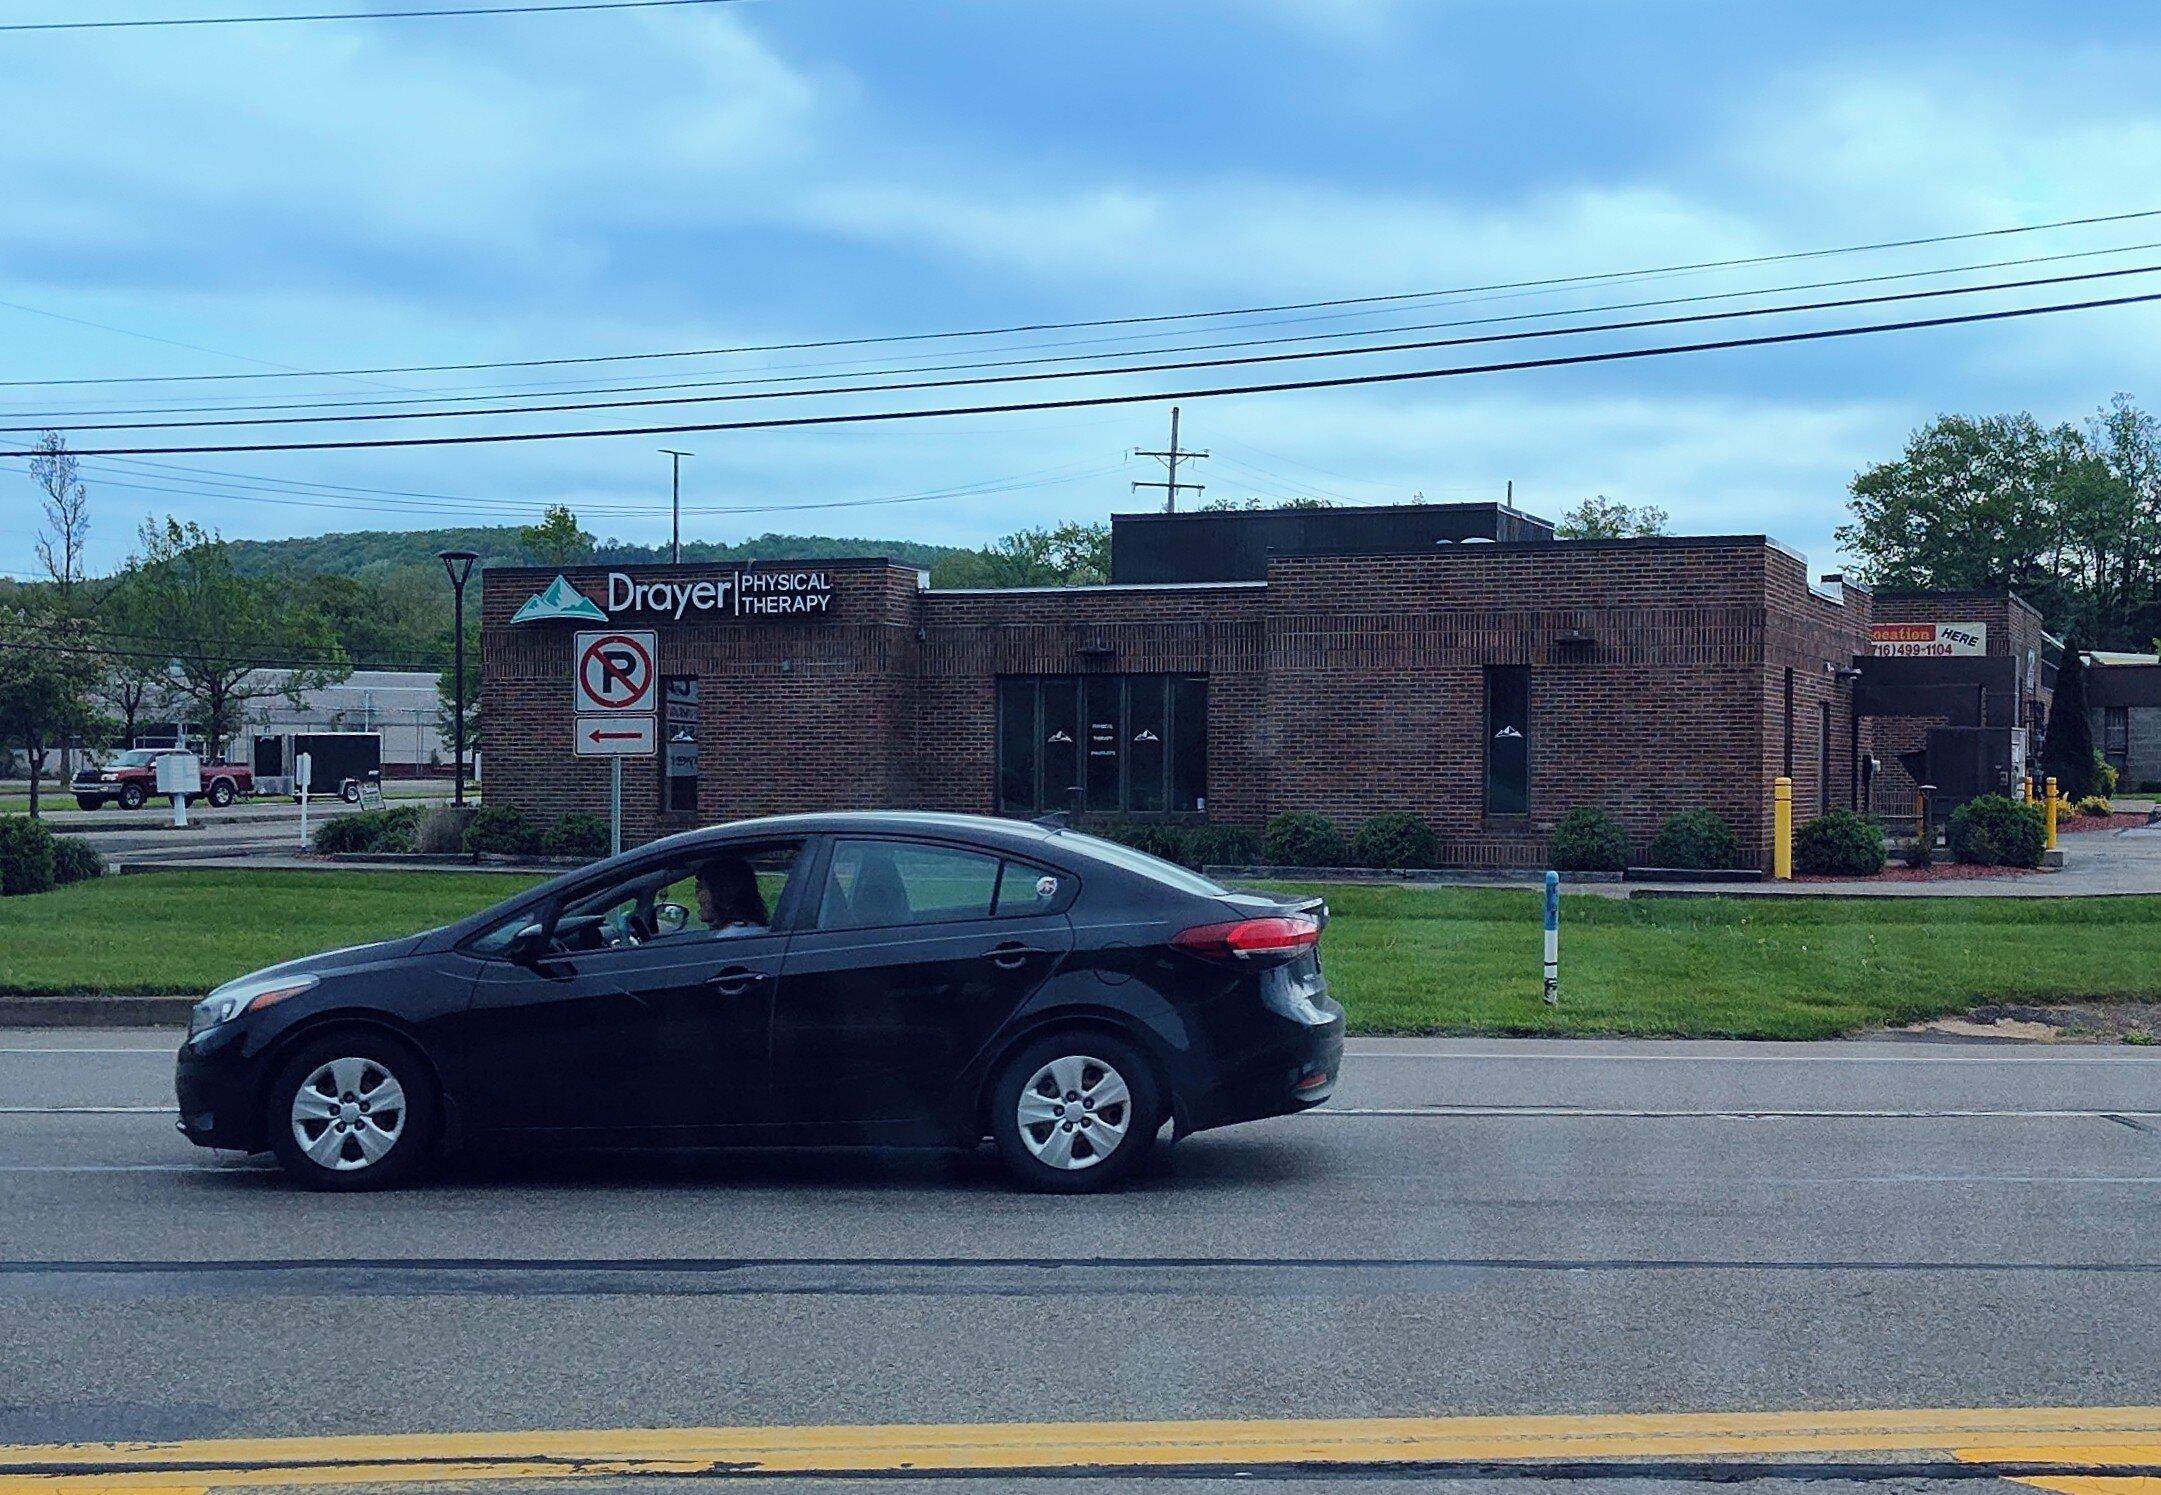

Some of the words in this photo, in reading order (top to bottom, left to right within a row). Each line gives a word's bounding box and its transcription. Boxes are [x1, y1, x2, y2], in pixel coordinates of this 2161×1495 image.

[741, 573, 831, 592] PHYSICAL
[608, 572, 731, 620] Drayer
[741, 595, 831, 614] THERAPY
[1941, 627, 1980, 647] HERE
[602, 650, 637, 694] P
